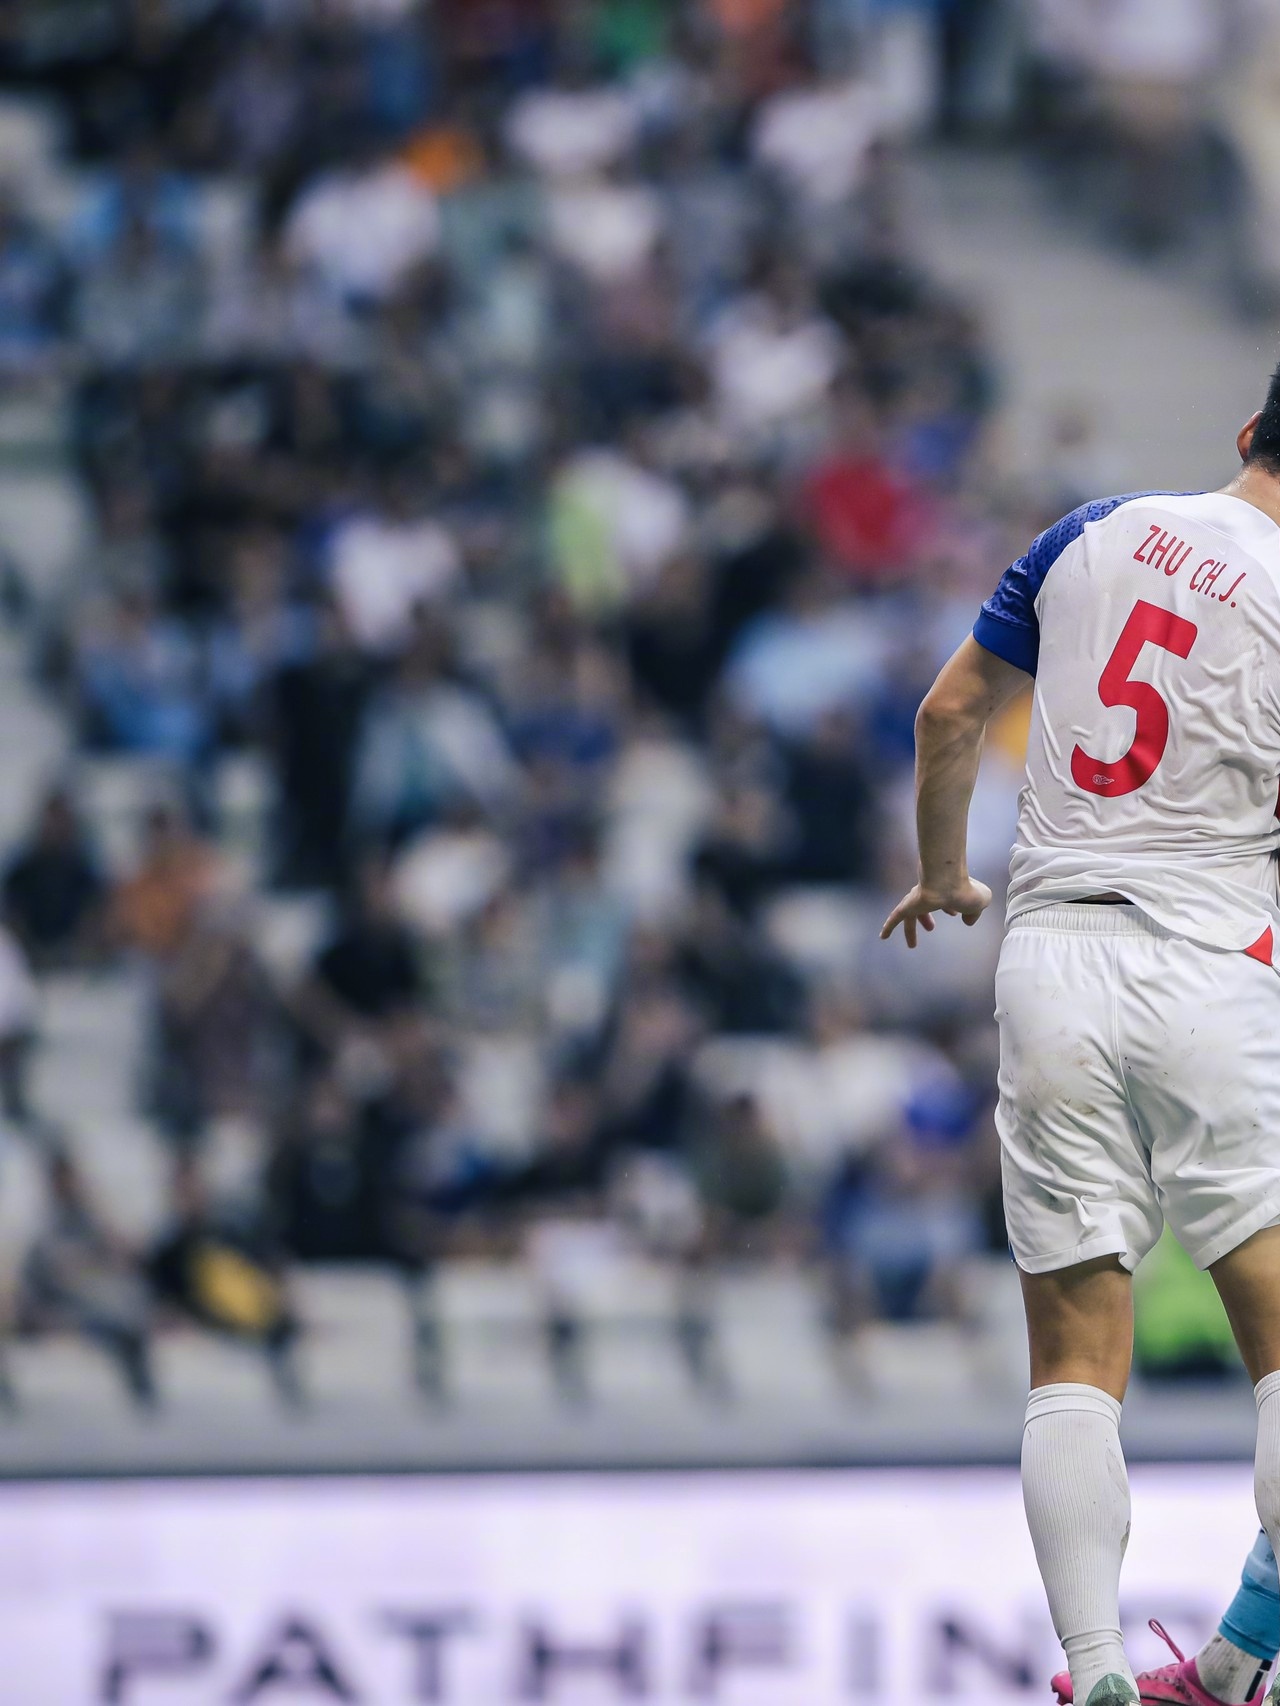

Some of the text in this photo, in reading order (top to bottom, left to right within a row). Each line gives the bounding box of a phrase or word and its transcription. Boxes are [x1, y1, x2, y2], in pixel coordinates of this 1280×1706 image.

[1133, 524, 1247, 608] ZHU CH.J.
[1070, 599, 1198, 798] 5
